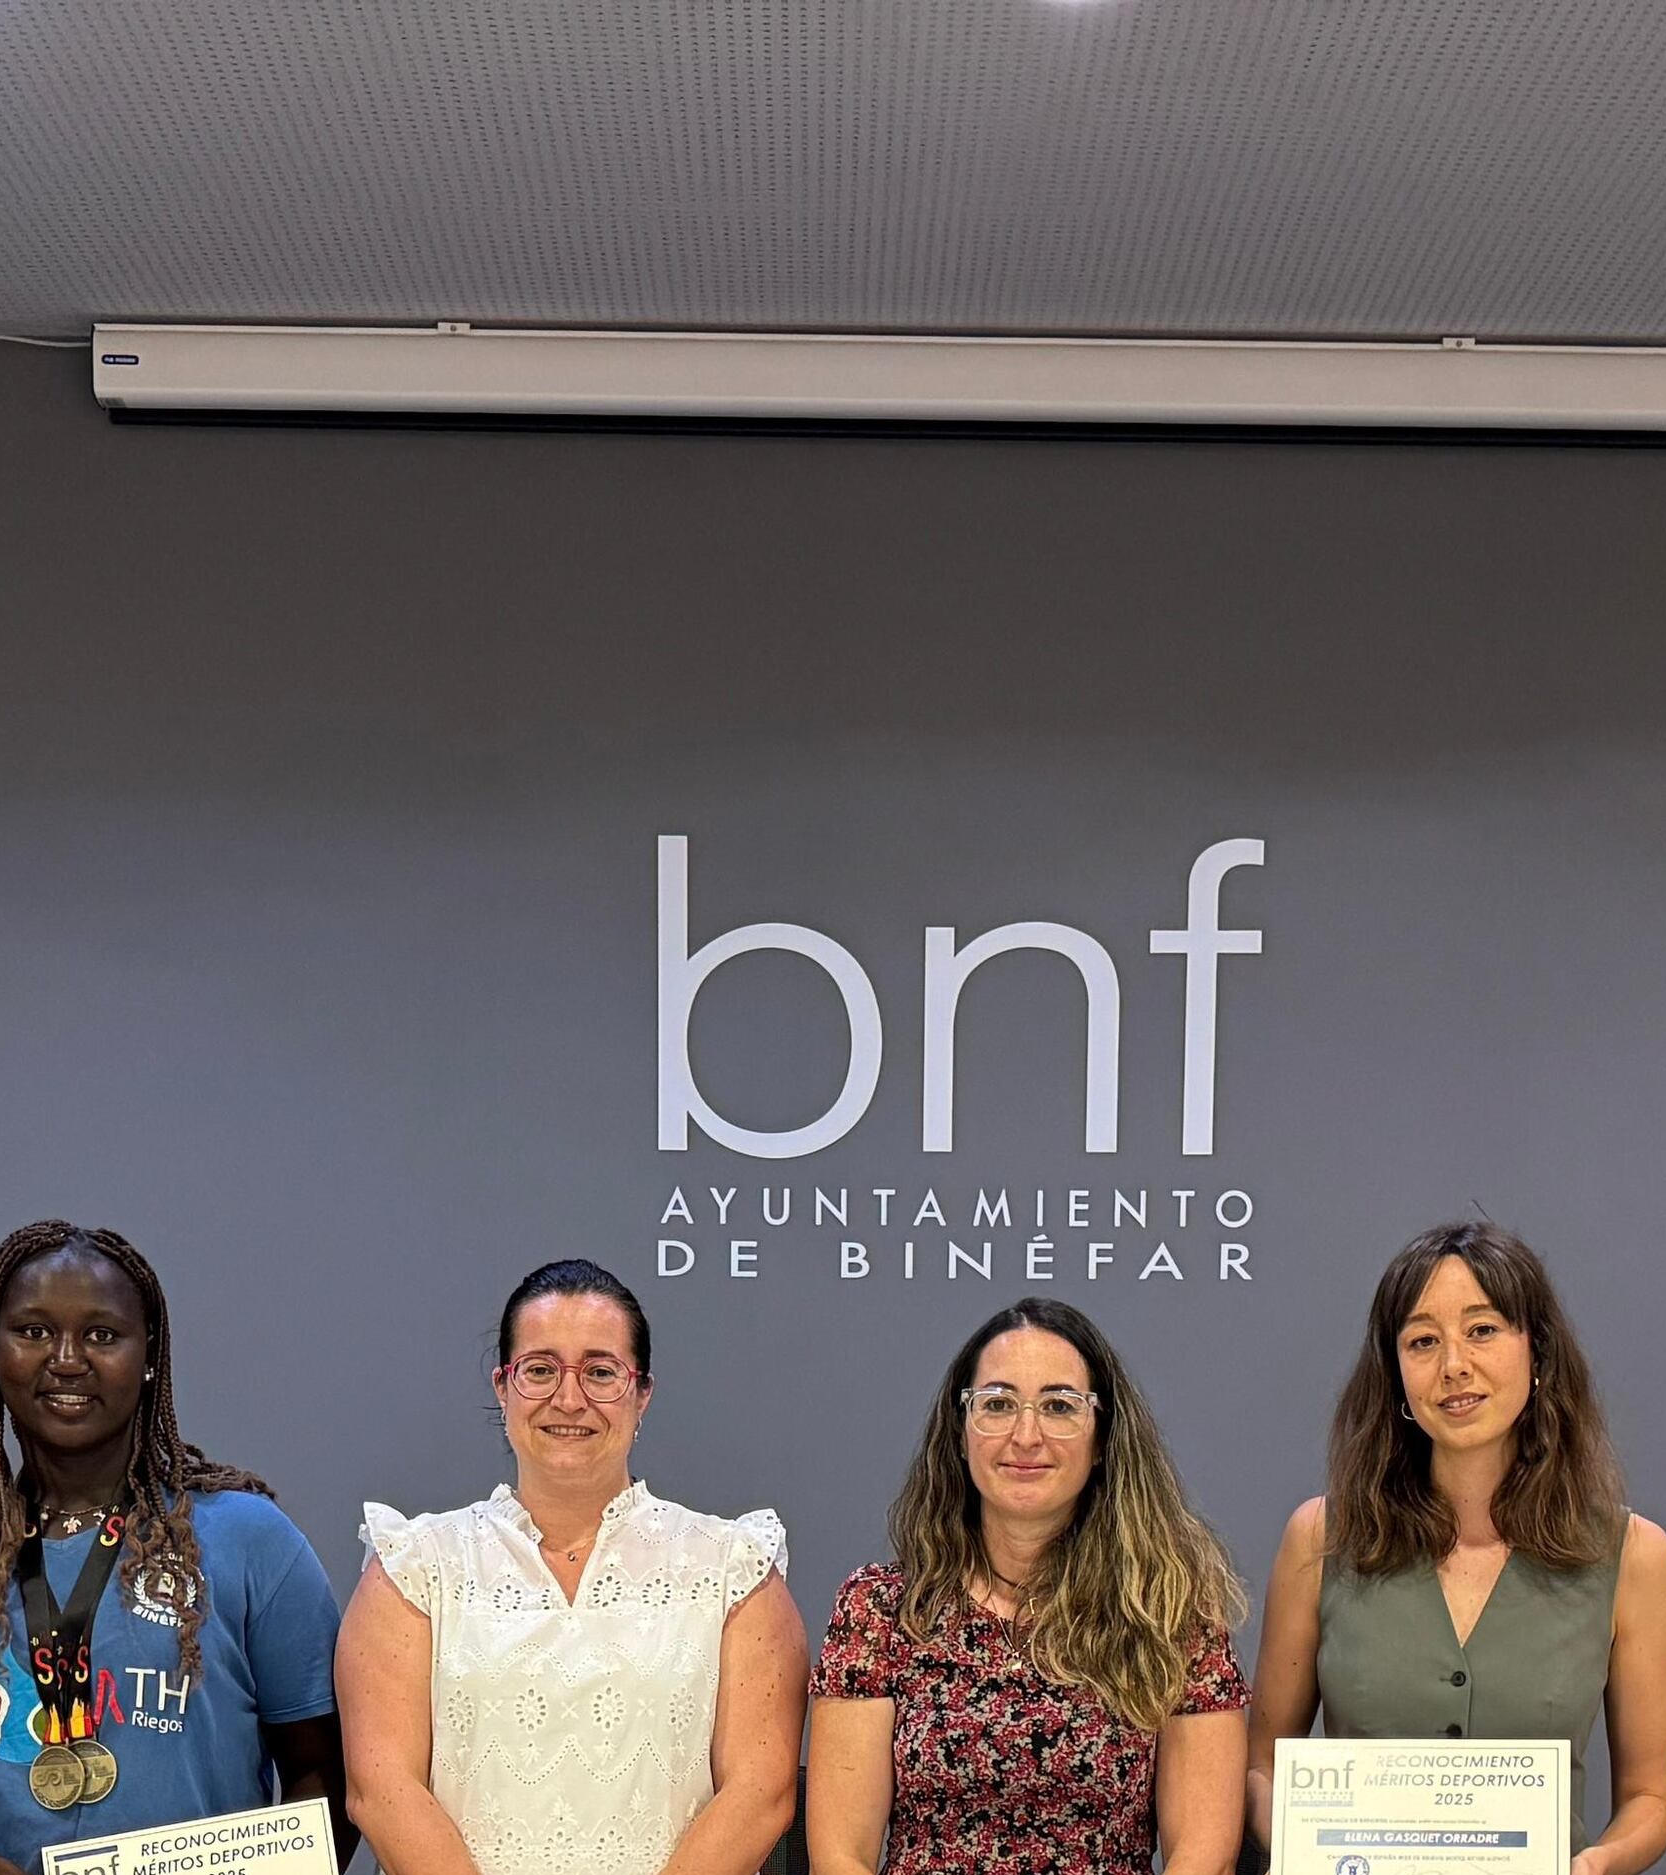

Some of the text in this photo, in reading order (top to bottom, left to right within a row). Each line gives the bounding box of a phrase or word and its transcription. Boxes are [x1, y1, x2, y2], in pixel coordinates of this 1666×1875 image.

[658, 835, 1265, 1160] bnf
[661, 1187, 1253, 1229] AYUNTAMIENTO
[657, 1233, 1253, 1281] DE BINÉFAR
[132, 1604, 185, 1628] BINÉF
[1375, 1754, 1534, 1769] RECONOCIMIENTO
[1440, 1773, 1545, 1788] DEPORTIVOS
[1433, 1791, 1474, 1806] 2025
[140, 1815, 301, 1857] RECONOCIMIENTO
[209, 1833, 314, 1866] DEPORTIVOS
[1341, 1830, 1499, 1845] ELENA GASQUET ORRADRE
